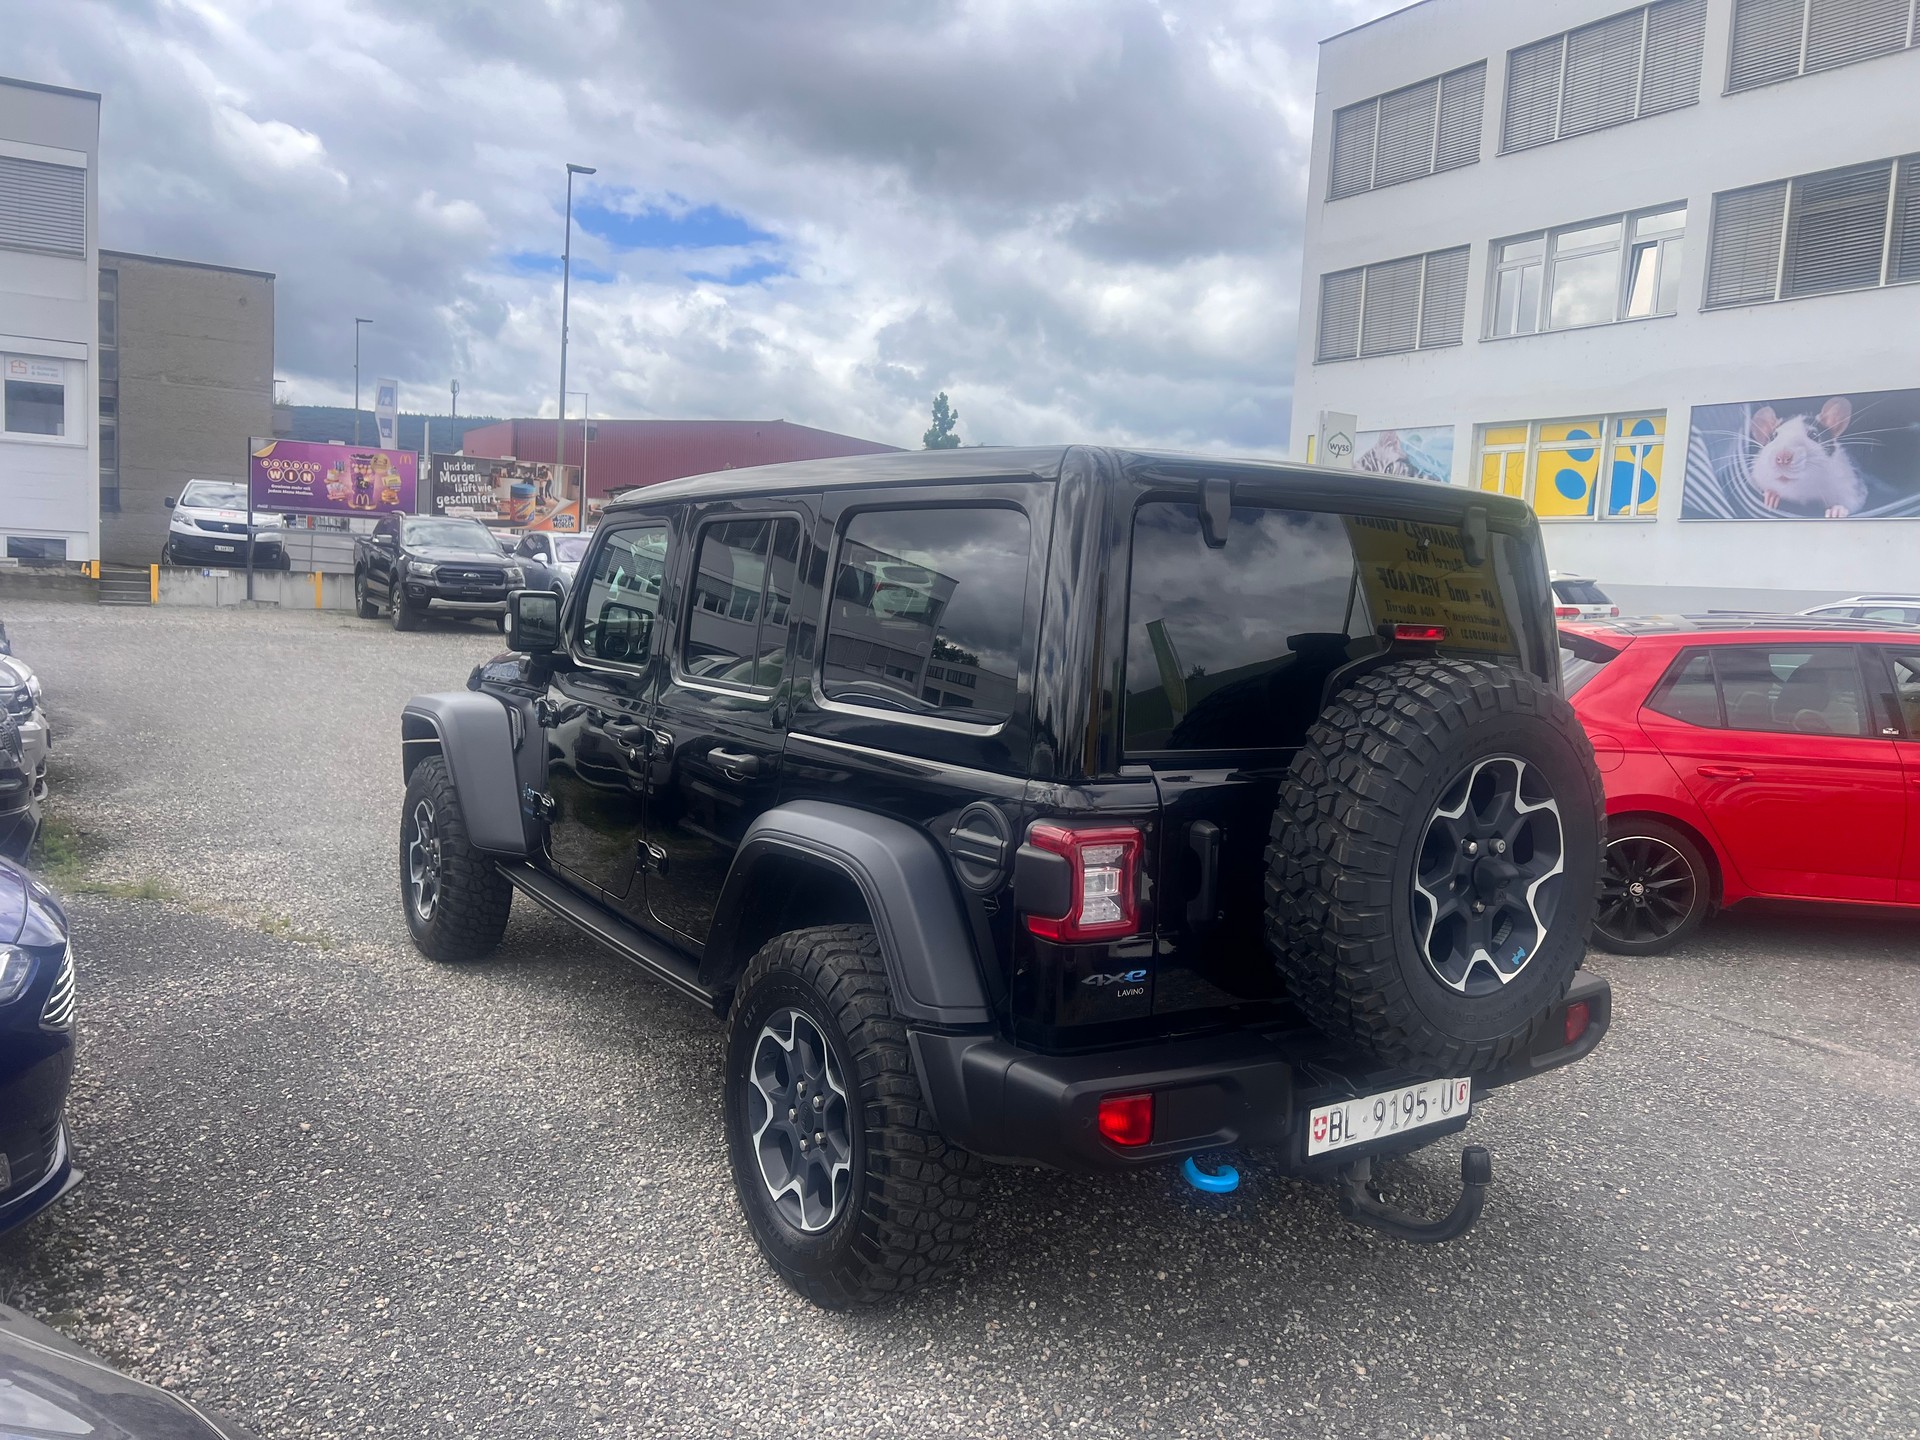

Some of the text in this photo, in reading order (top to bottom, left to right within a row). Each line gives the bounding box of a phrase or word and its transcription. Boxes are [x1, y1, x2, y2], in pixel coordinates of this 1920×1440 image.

[262, 459, 320, 472] GOLDEN
[443, 461, 475, 471] Und der
[268, 469, 314, 482] WIN
[440, 472, 481, 485] Morgen
[455, 483, 492, 493] läuft wie
[436, 493, 500, 508] geschmiert.
[1117, 987, 1144, 998] LAVINO
[1329, 1082, 1454, 1146] BL 9195 U
